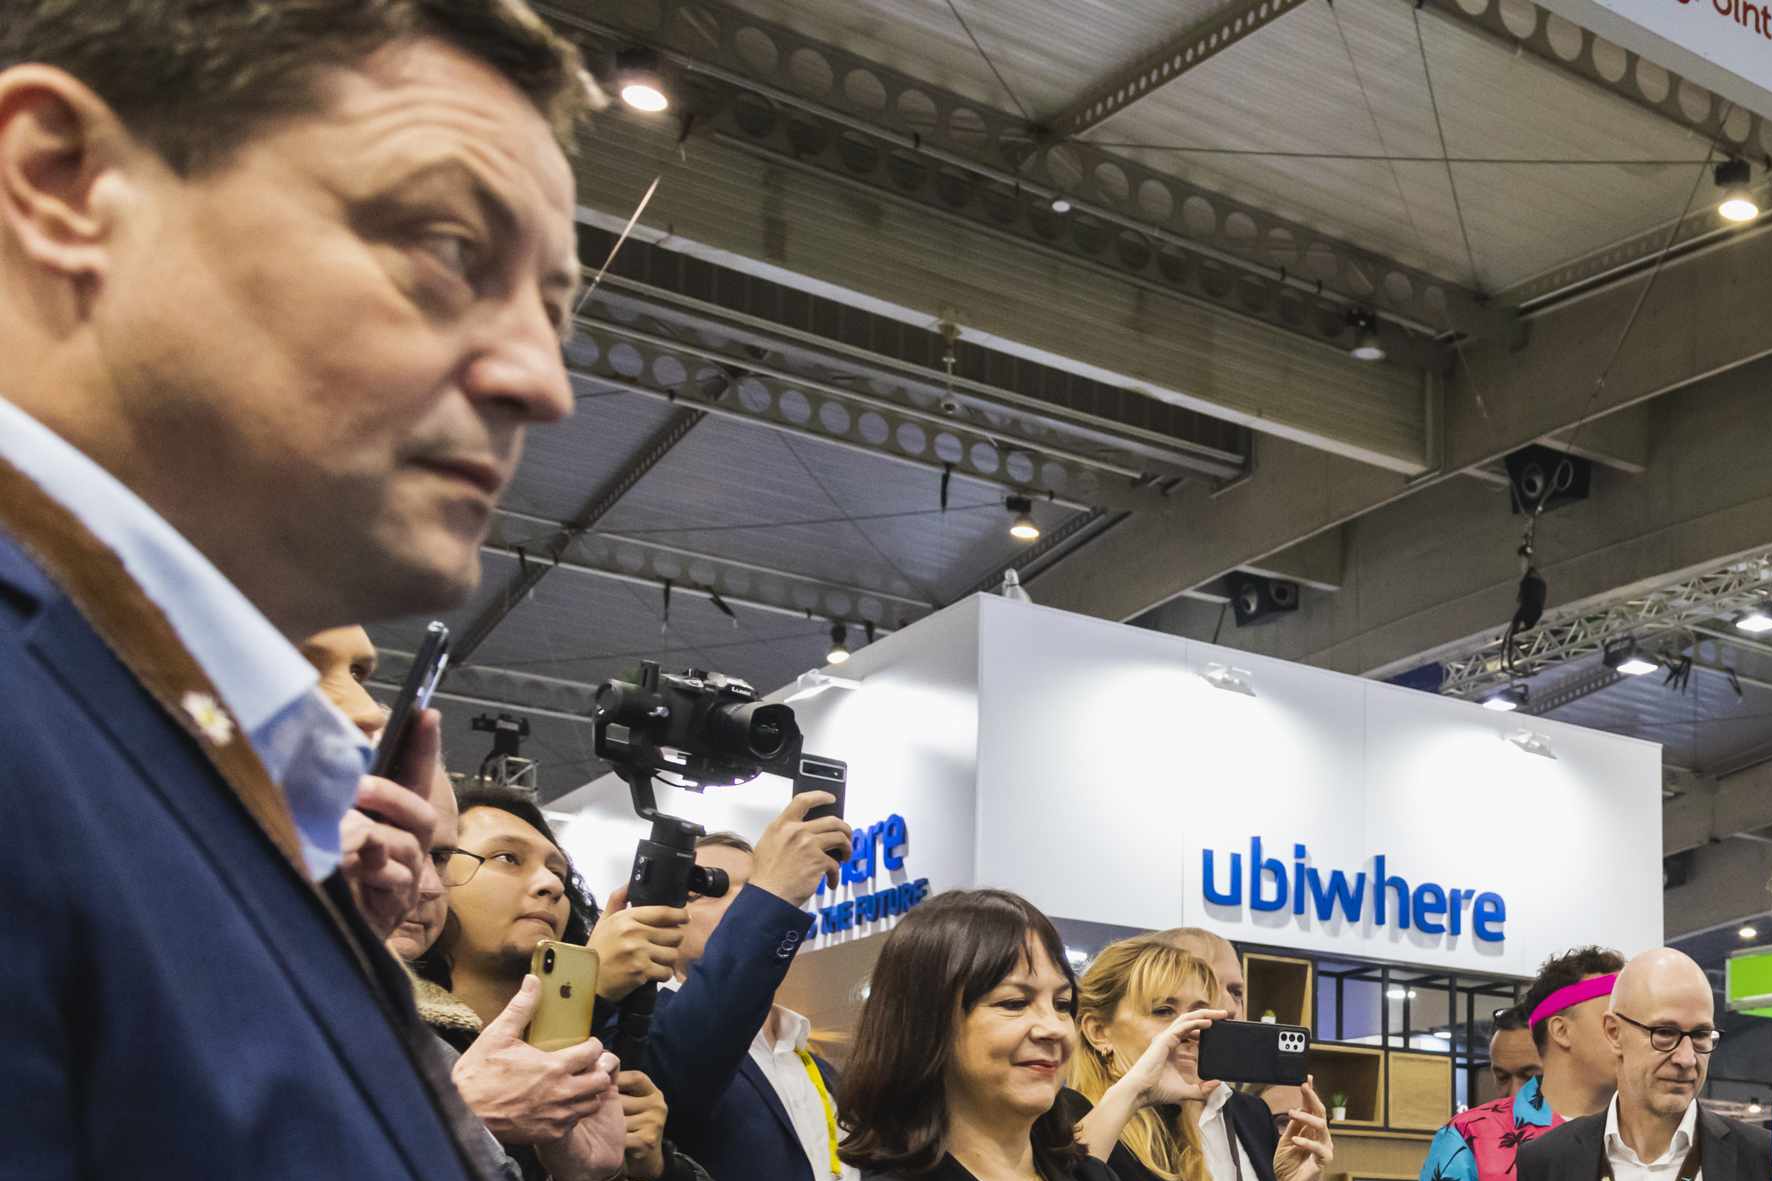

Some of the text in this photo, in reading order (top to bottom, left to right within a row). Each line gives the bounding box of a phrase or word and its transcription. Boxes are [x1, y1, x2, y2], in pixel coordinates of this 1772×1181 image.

[819, 900, 854, 935] THE
[855, 877, 929, 926] FUTURE
[1202, 836, 1506, 943] ubiwhere
